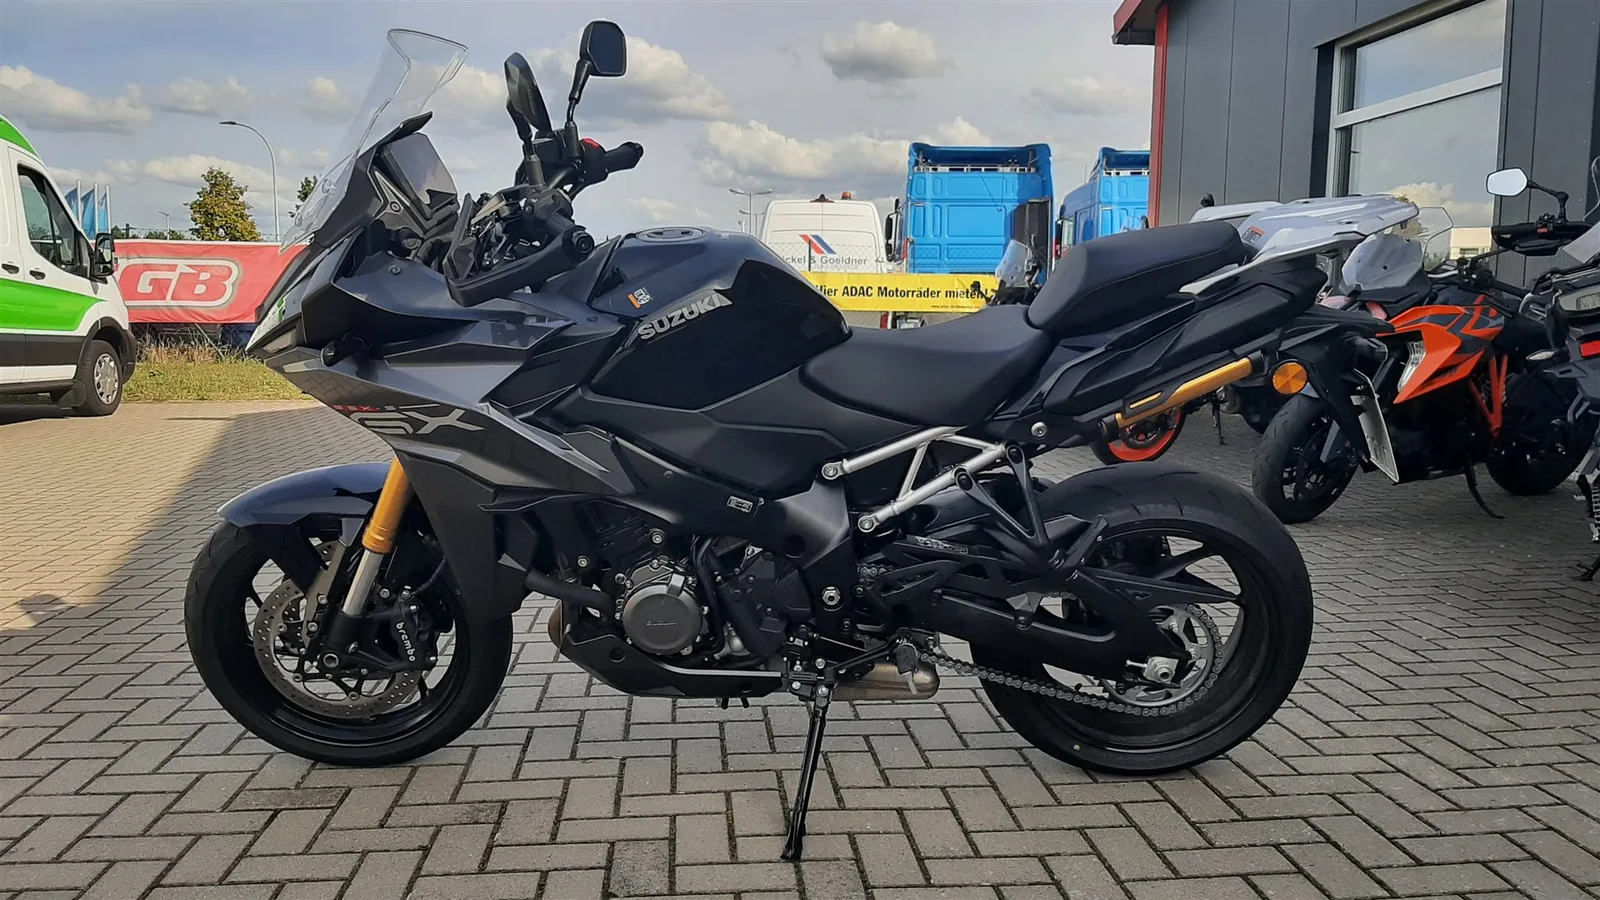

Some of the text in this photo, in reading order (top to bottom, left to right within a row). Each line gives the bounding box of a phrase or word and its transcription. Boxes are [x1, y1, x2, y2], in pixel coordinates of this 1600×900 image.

[820, 256, 867, 265] Goeldner
[118, 263, 233, 301] GB
[842, 286, 873, 297] ADAC
[878, 286, 941, 298] Motorräder
[638, 293, 721, 340] SUZUKI
[396, 621, 416, 662] brembo
